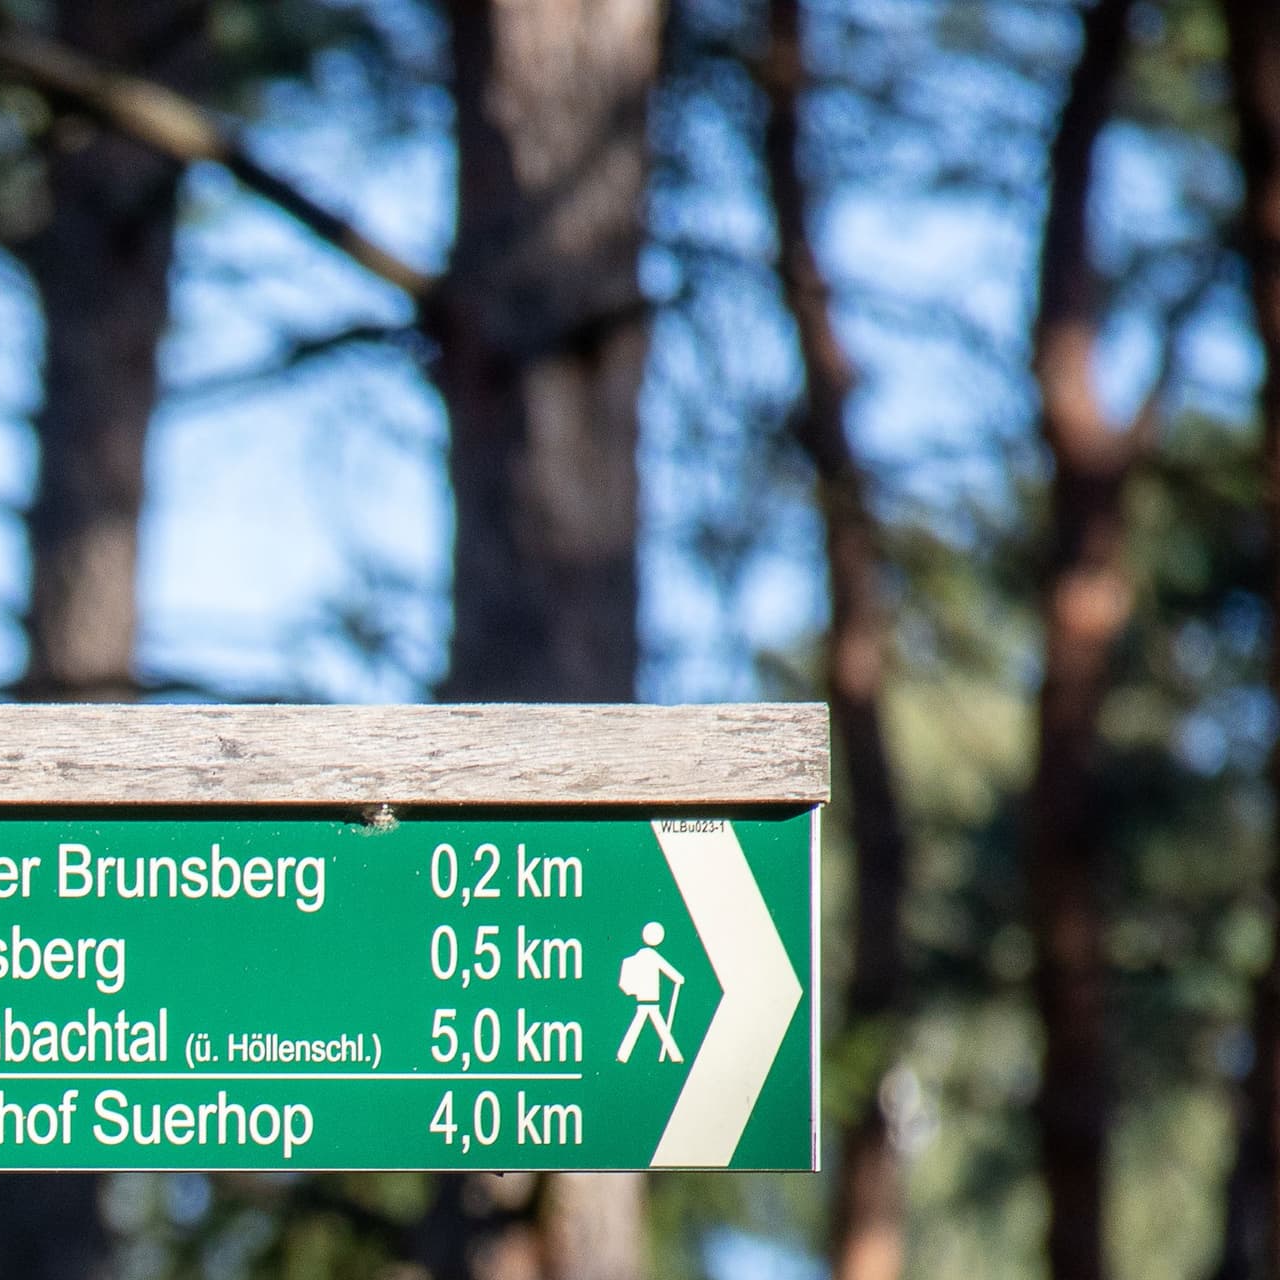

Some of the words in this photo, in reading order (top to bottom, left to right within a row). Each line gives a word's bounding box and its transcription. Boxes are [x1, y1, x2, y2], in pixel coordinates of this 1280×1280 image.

[59, 844, 325, 912] Brunsberg
[431, 844, 500, 907] 0,2
[518, 844, 582, 898] km
[431, 926, 500, 988] 0,5
[518, 926, 582, 979] km
[186, 1034, 218, 1068] (ü.
[229, 1034, 381, 1069] Höllenschl.)
[432, 1008, 500, 1071] 5,0
[518, 1008, 582, 1062] km
[93, 1090, 313, 1158] Suerhop
[430, 1091, 500, 1153] 4,0
[518, 1091, 582, 1144] km
